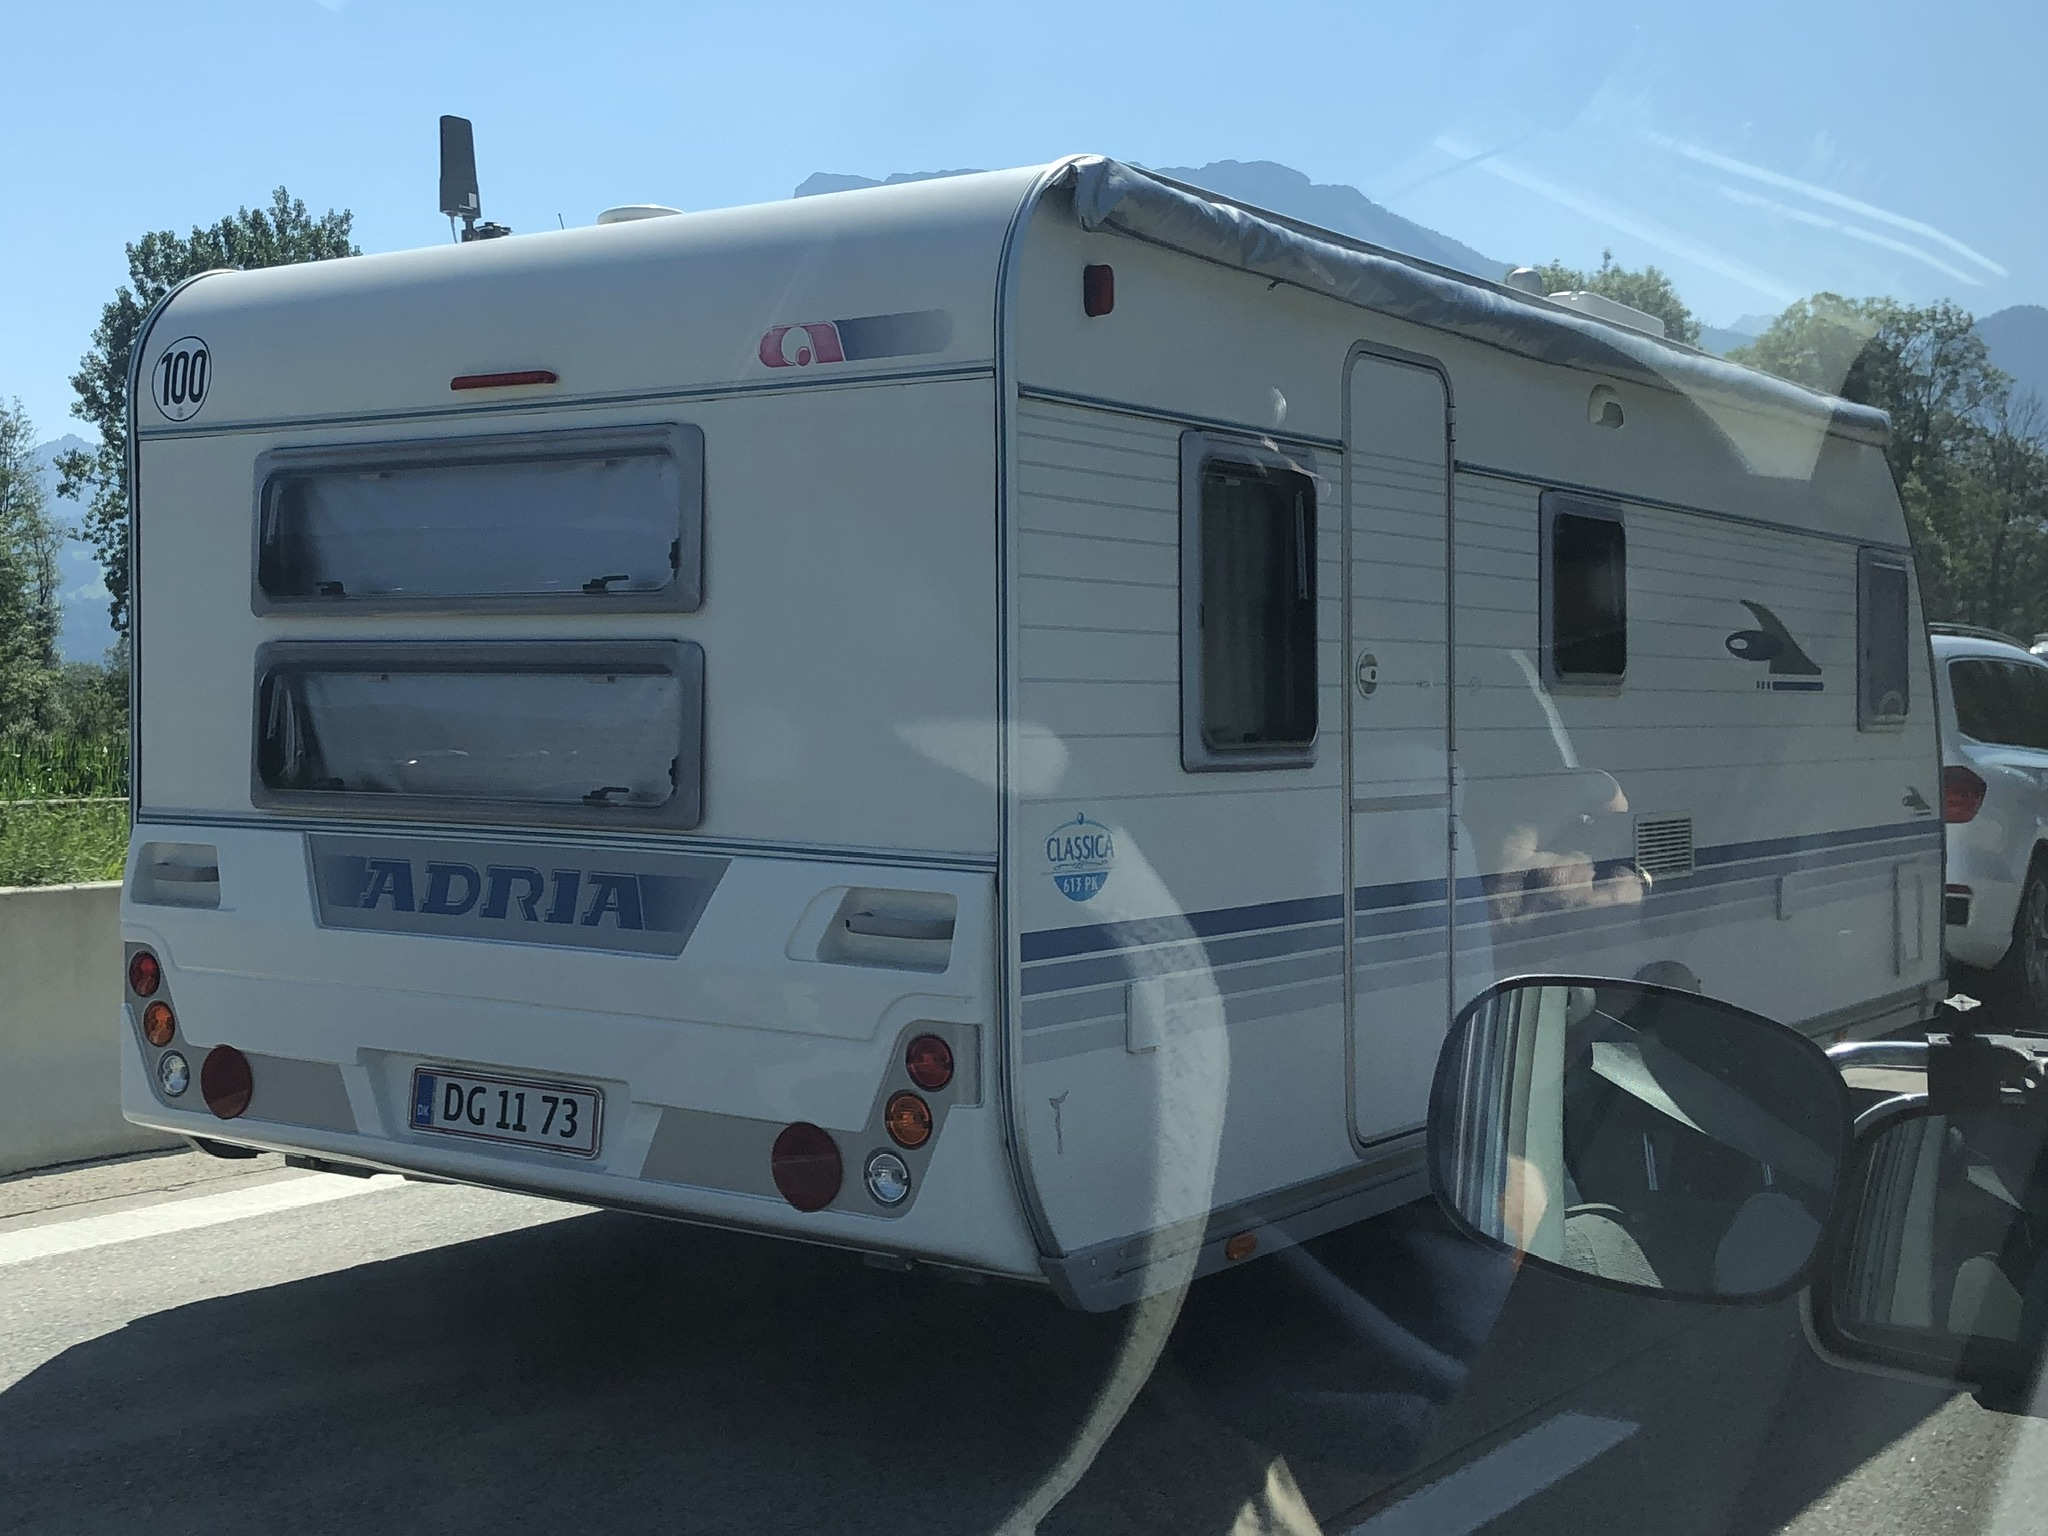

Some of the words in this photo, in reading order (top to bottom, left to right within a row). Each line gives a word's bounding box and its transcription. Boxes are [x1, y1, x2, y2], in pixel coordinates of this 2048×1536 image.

[161, 350, 207, 406] 100
[1046, 834, 1114, 862] CLASSICA
[360, 858, 645, 930] ADRIA
[1085, 876, 1098, 891] PK
[417, 1104, 430, 1117] DK
[443, 1083, 487, 1125] DG
[496, 1090, 527, 1132] 11
[541, 1095, 578, 1138] 73
